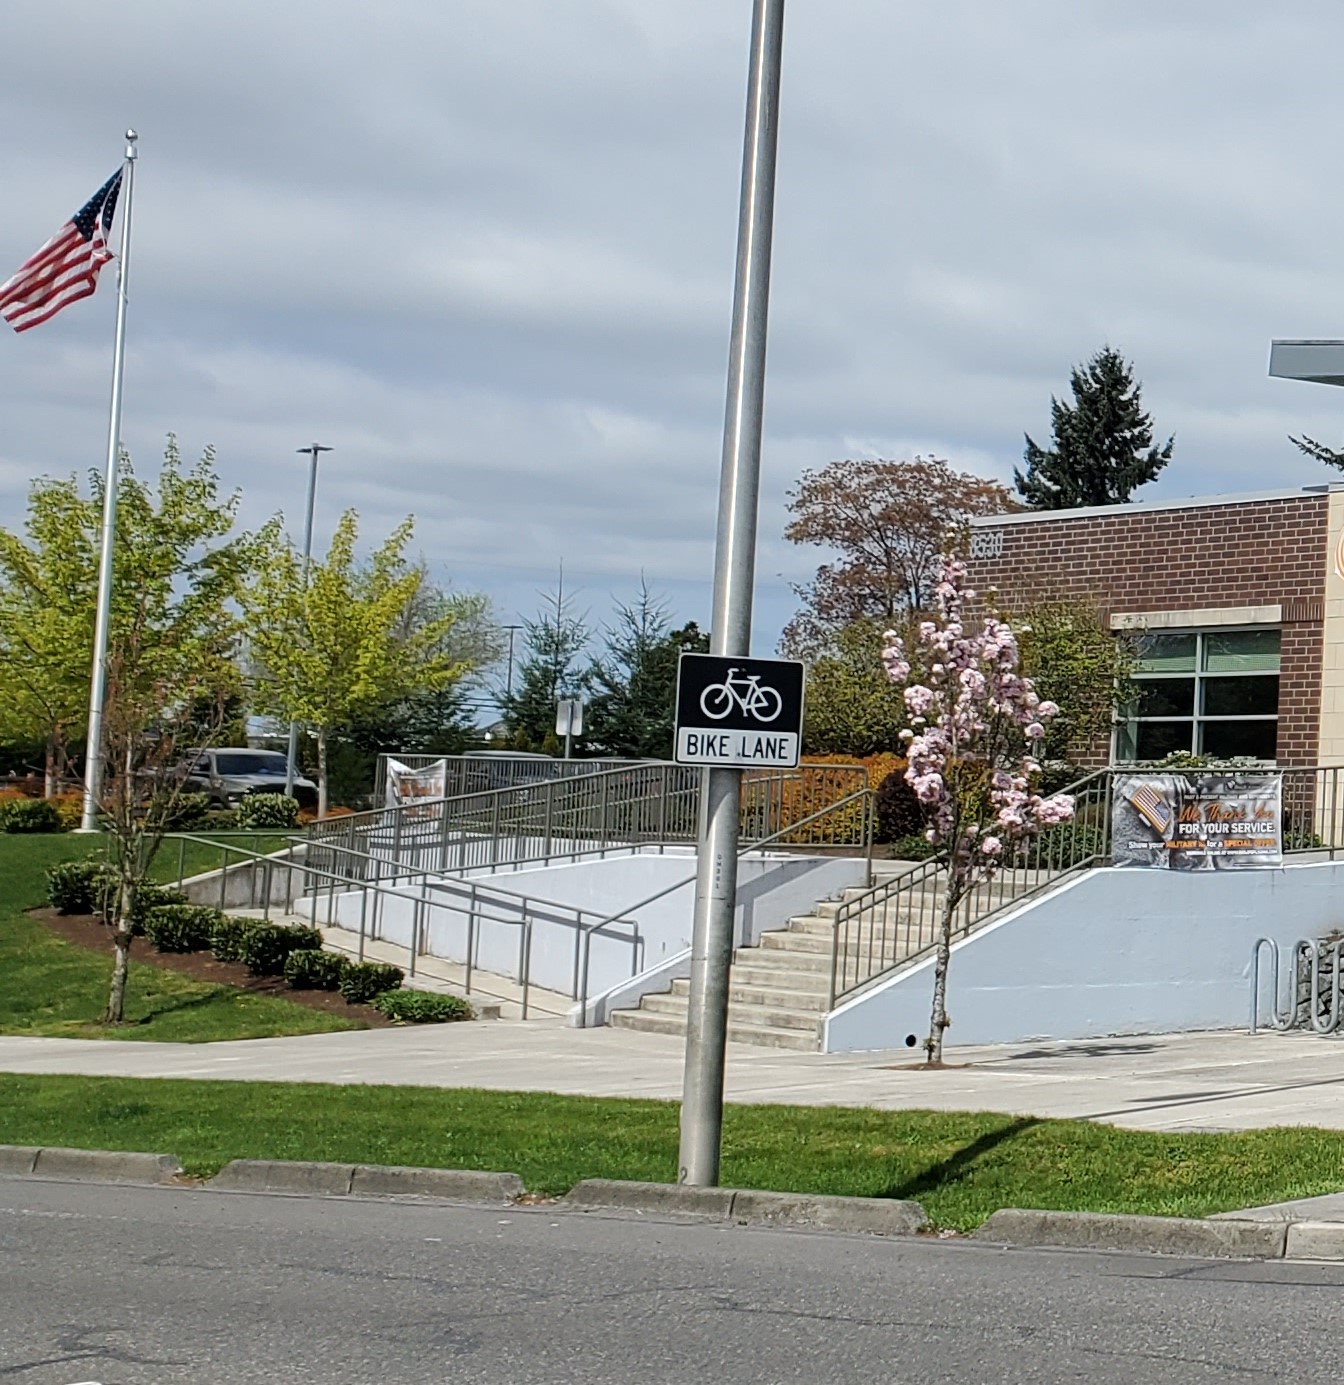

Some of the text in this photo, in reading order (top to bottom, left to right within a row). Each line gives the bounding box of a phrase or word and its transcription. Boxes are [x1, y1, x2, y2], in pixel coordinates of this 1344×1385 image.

[687, 734, 789, 759] BIKE LANE
[1179, 822, 1275, 834] FOR YOUR SERVICE.
